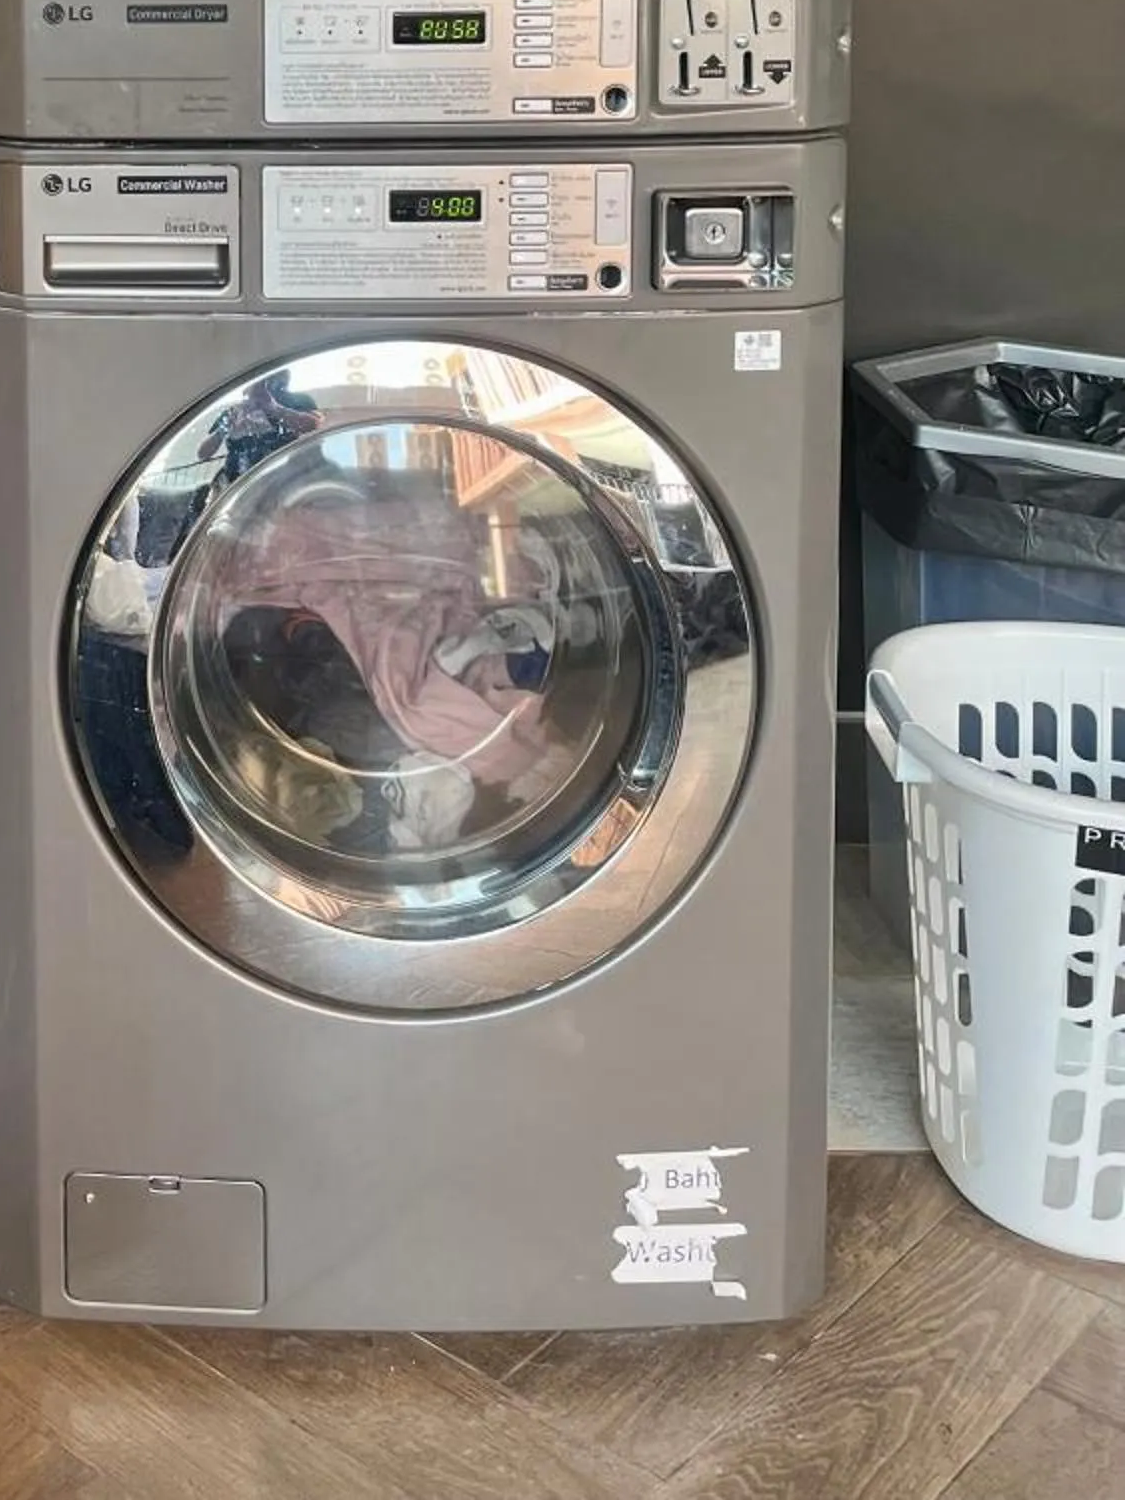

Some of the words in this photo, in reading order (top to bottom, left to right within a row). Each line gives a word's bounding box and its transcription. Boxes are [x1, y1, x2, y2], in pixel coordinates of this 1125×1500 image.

[68, 5, 94, 21] LG
[129, 7, 192, 21] Commercial
[194, 7, 225, 22] Dryer
[67, 177, 92, 193] LG
[119, 179, 182, 192] Commercial
[184, 179, 226, 192] Washer
[626, 1239, 716, 1264] Wash
